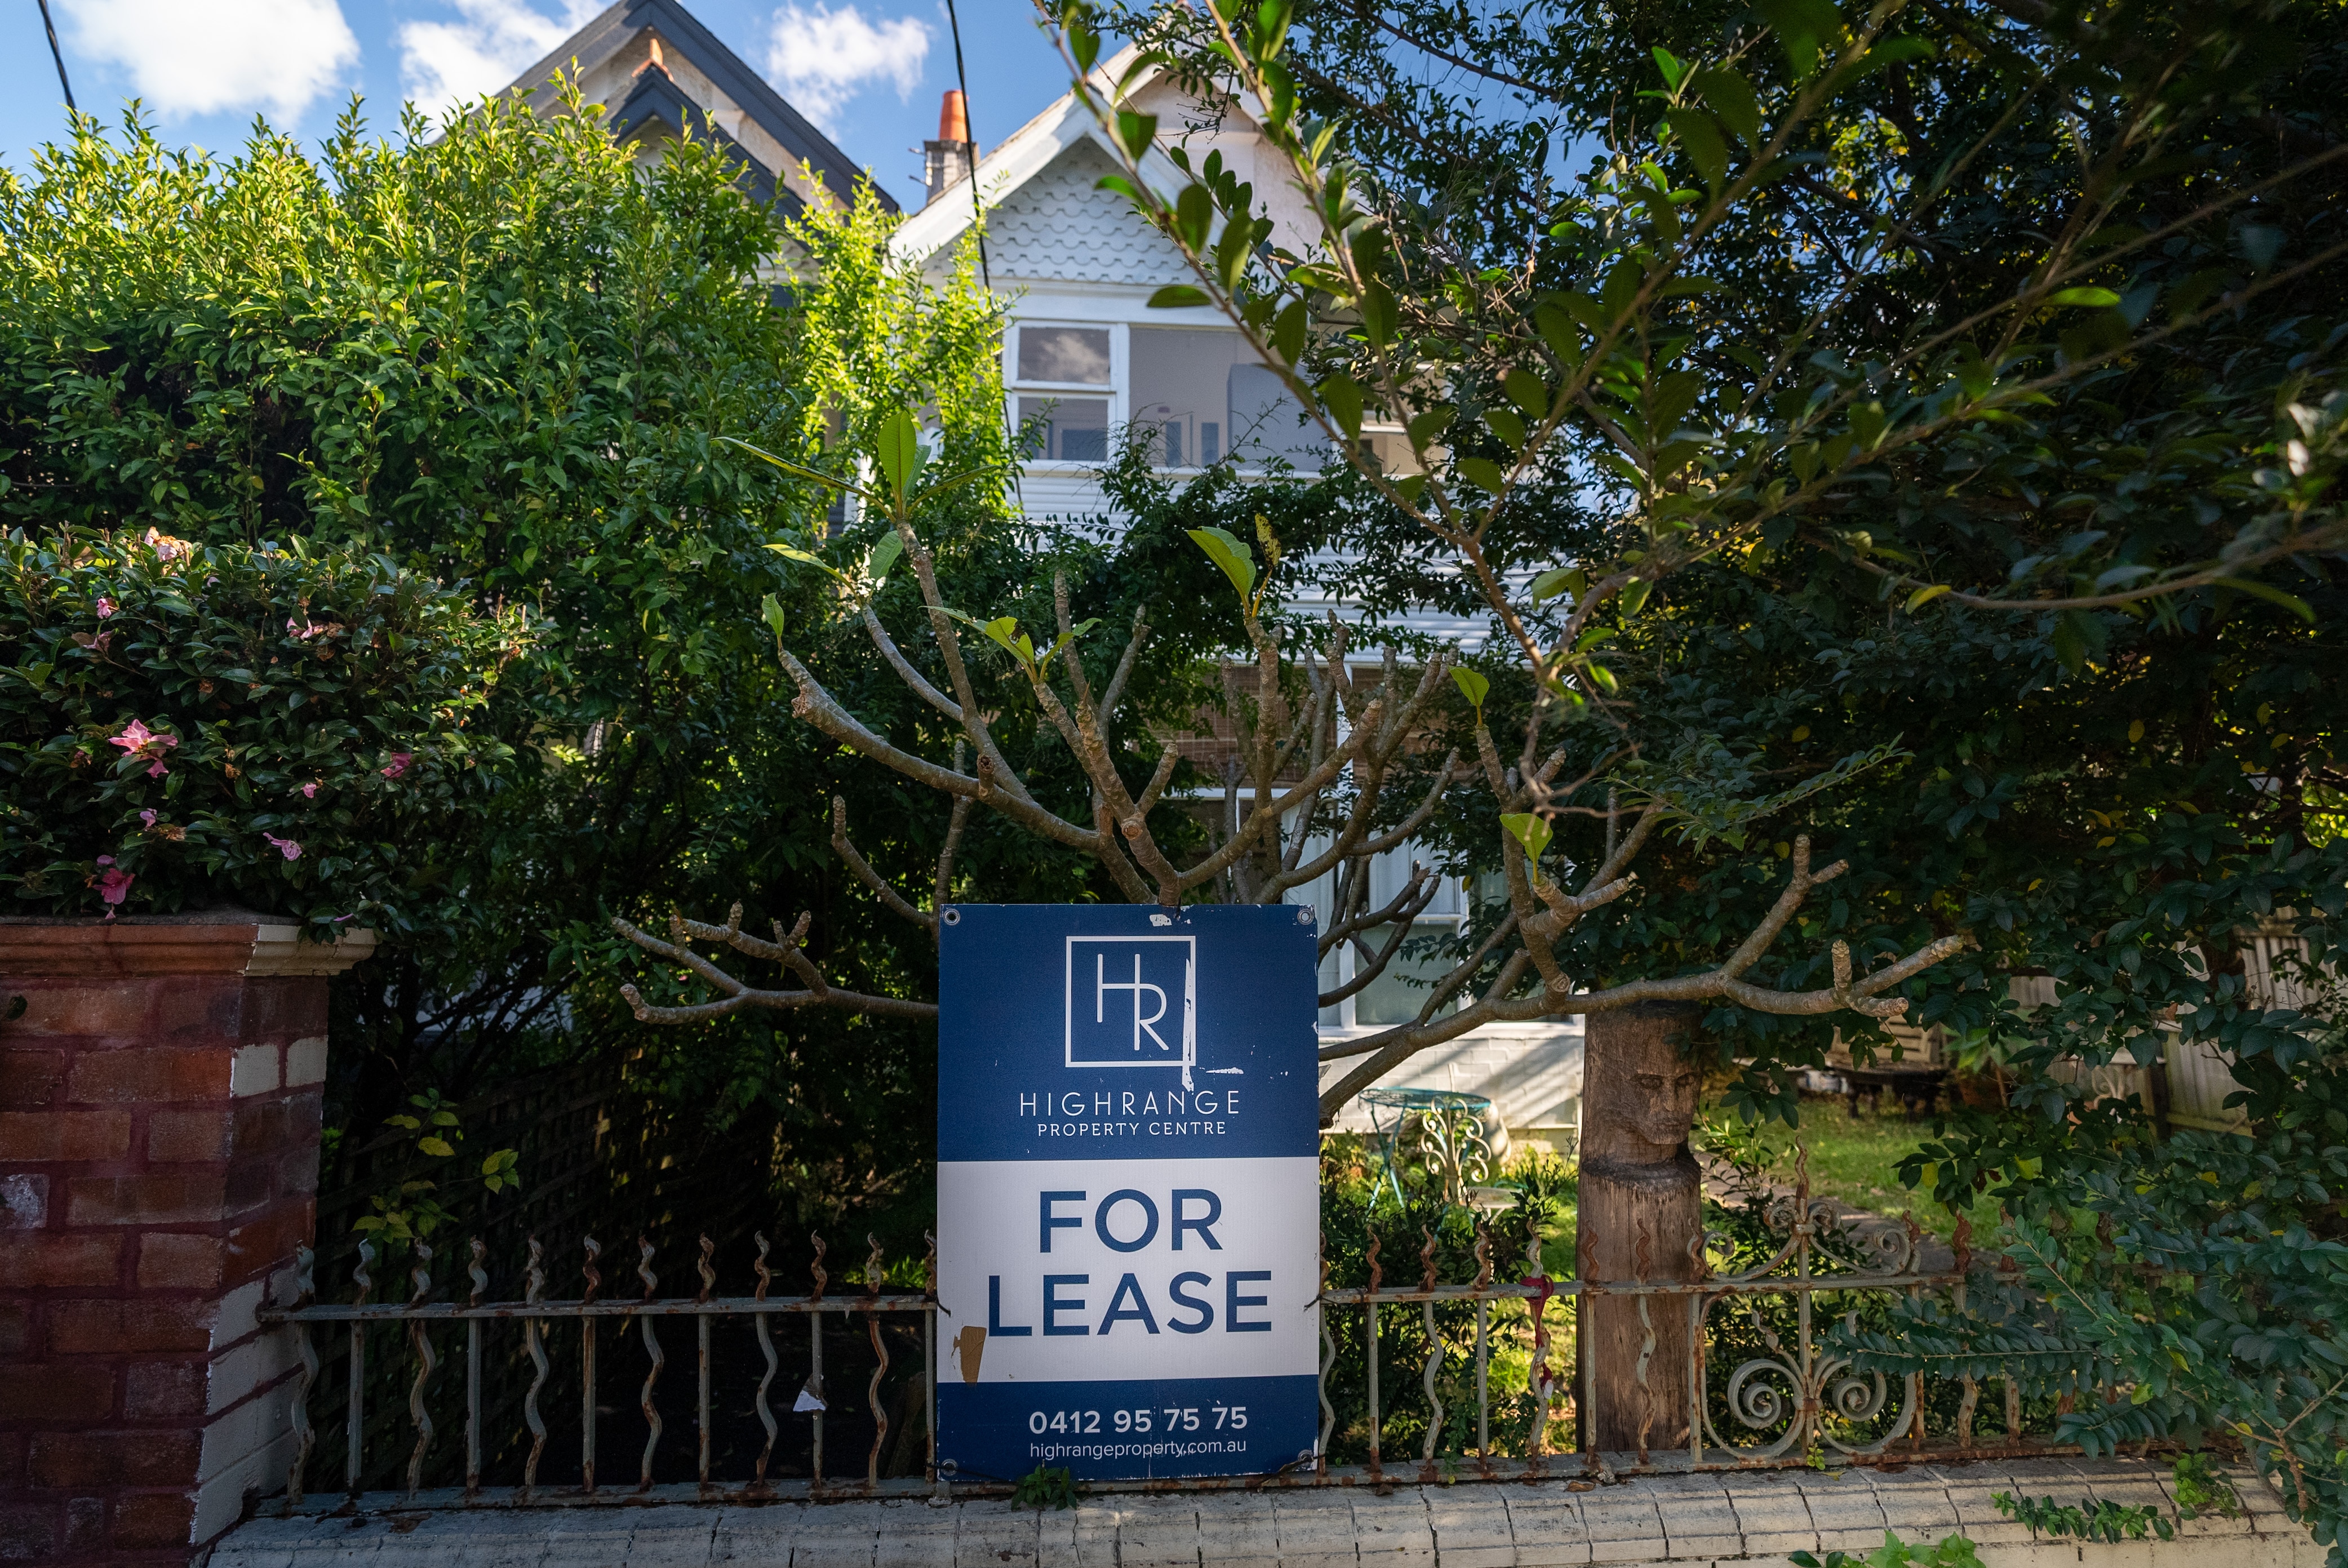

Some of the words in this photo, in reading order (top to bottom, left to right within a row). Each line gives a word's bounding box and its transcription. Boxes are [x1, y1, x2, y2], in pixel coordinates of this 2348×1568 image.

[1097, 954, 1169, 1050] HR
[1020, 1090, 1239, 1116] HIGHRANGE
[1038, 1122, 1139, 1136] PROPERTY
[1149, 1121, 1226, 1135] CENTRE
[1040, 1189, 1223, 1253] FOR
[988, 1271, 1272, 1337] LEASE
[1029, 1410, 1101, 1434] 0412
[1113, 1409, 1152, 1433] 95
[1163, 1409, 1200, 1432] 75
[1211, 1406, 1248, 1430] 75
[1030, 1440, 1246, 1461] highrangeproperty.com.au
